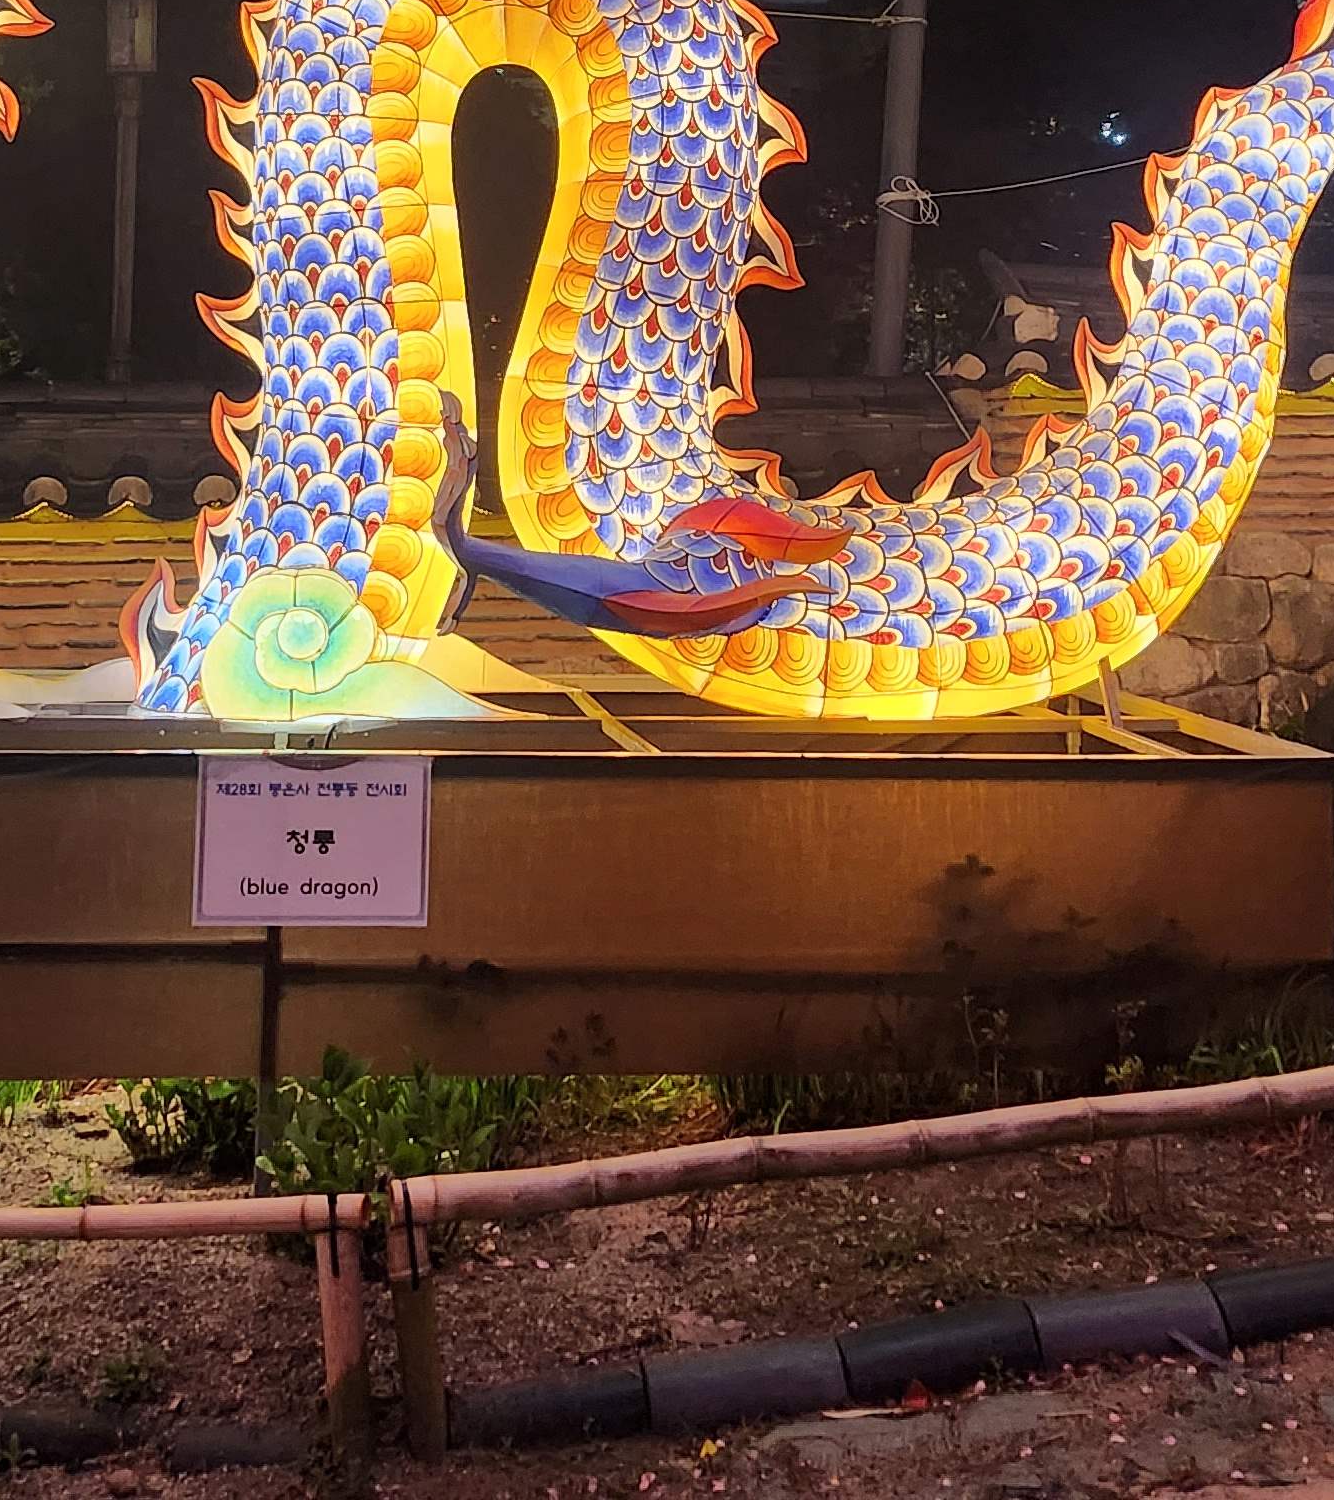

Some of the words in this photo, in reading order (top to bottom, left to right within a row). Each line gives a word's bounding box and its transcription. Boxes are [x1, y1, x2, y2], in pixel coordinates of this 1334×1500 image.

[217, 783, 261, 796] 제28회
[269, 783, 310, 797] 봉은사
[367, 783, 407, 797] 전시회
[286, 830, 335, 855] 청룡
[240, 877, 289, 897] (blue
[300, 877, 379, 899] dragon)
